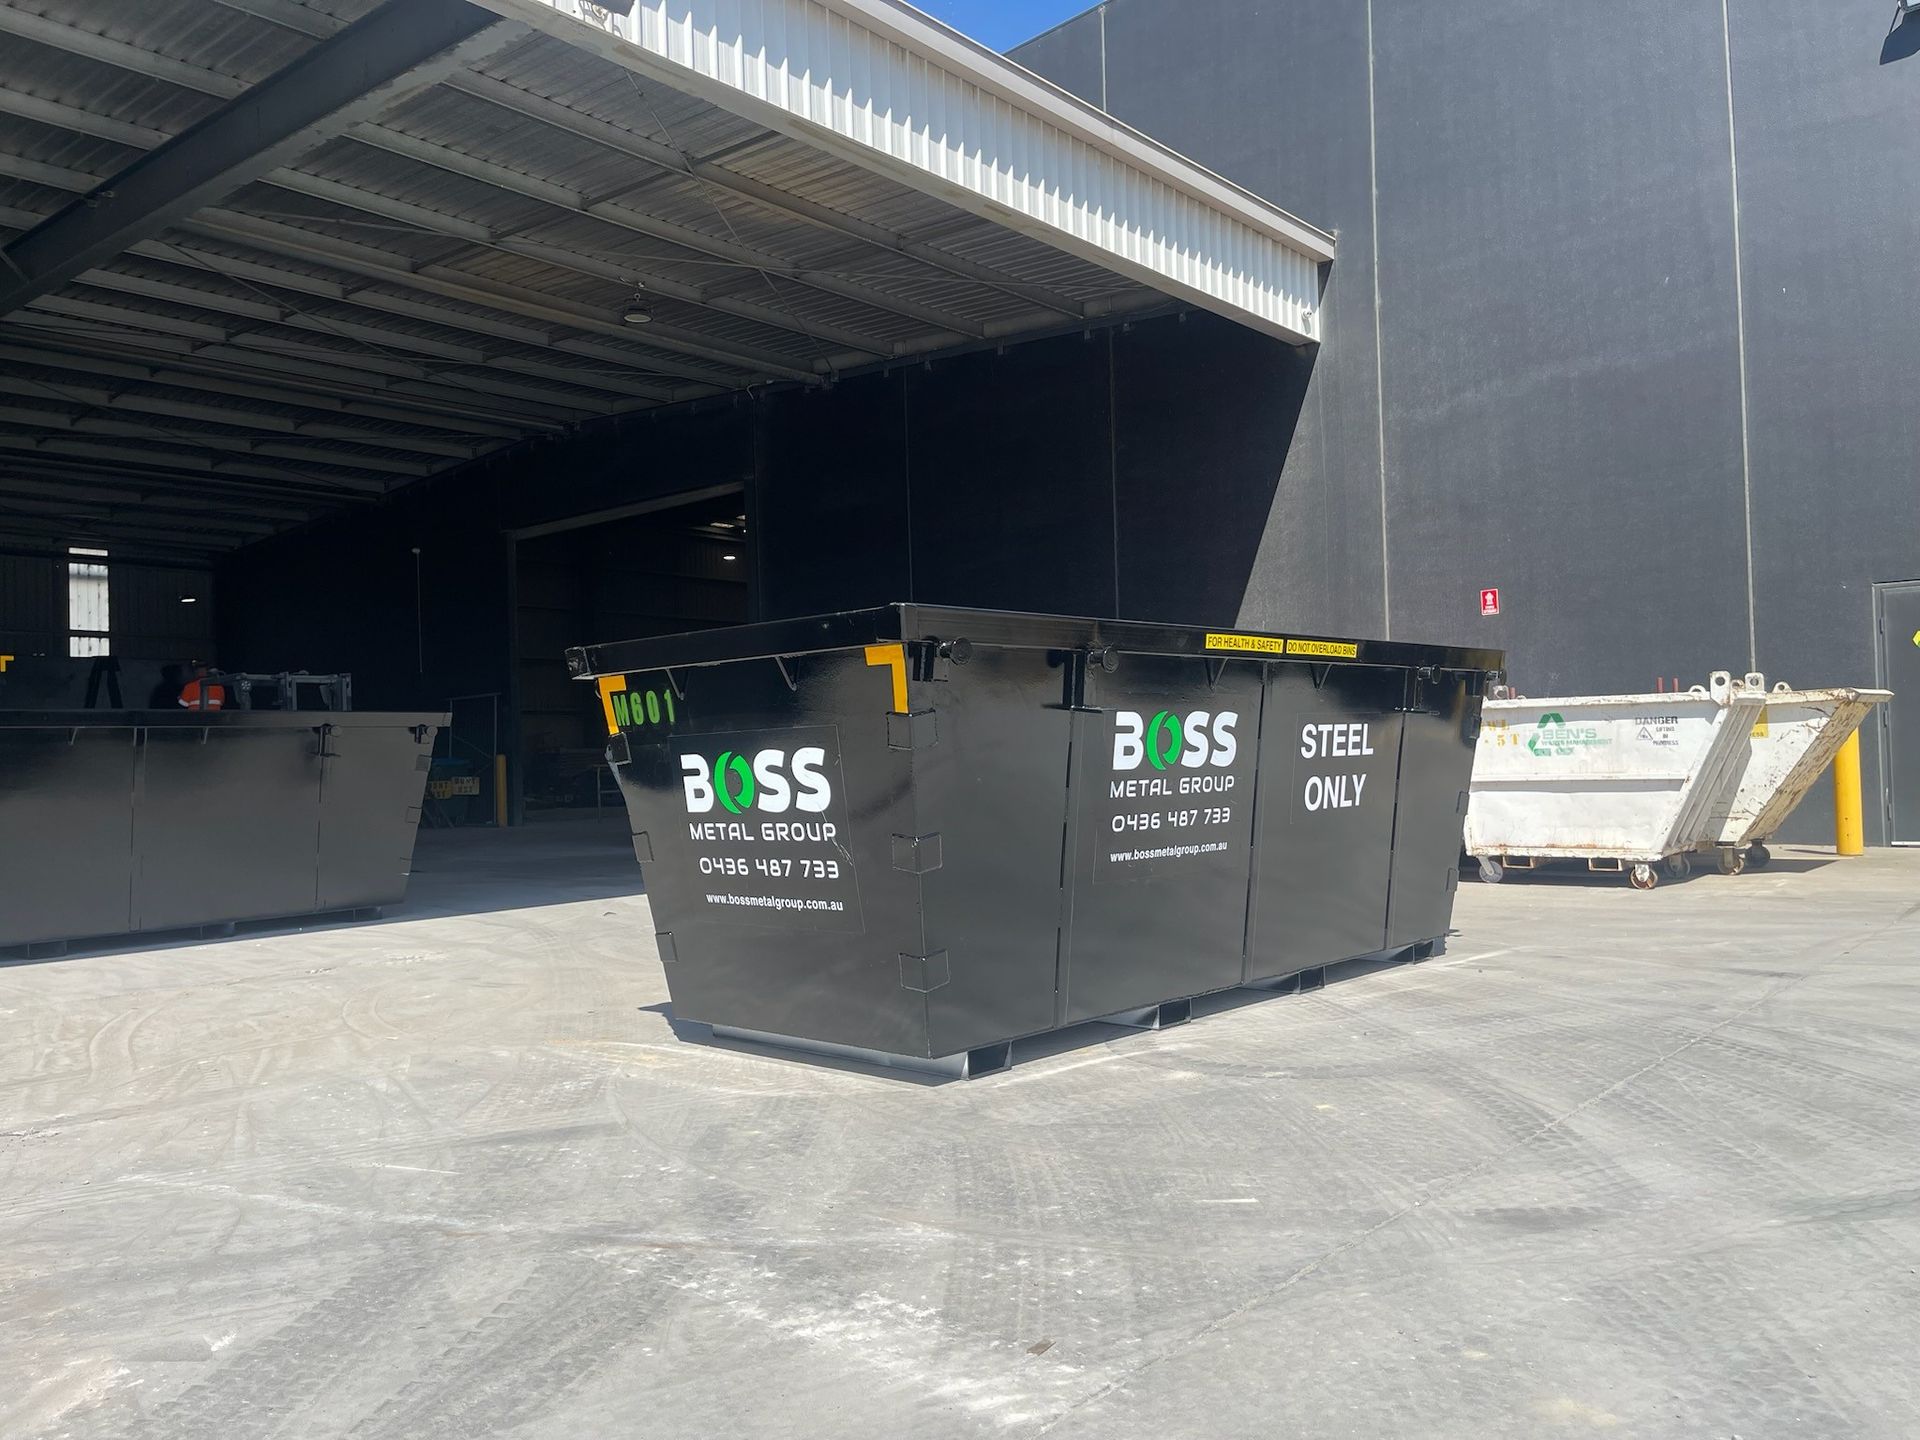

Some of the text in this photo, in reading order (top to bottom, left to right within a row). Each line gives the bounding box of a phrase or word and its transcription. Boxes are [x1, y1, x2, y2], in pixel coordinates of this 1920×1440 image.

[1207, 636, 1282, 651] FOR HEALTH & SAFETY
[1288, 641, 1356, 656] DO NOT OVERLOAD BINS
[613, 690, 675, 725] M601
[1635, 715, 1679, 725] DANGER
[1112, 710, 1238, 771] BOSS
[1301, 723, 1374, 759] STEEL
[1542, 728, 1597, 740] BEN'S
[680, 747, 831, 814] BOSS
[1109, 775, 1235, 798] METAL GROUP
[1304, 774, 1367, 811] ONLY
[1112, 807, 1231, 832] 0436 487 733
[689, 823, 836, 841] METAL GROUP
[1110, 841, 1228, 862] www.bossmetalgroup.com.au
[699, 857, 839, 879] 0436 487 733
[706, 893, 844, 912] www.bossmetalgroup.com.au
